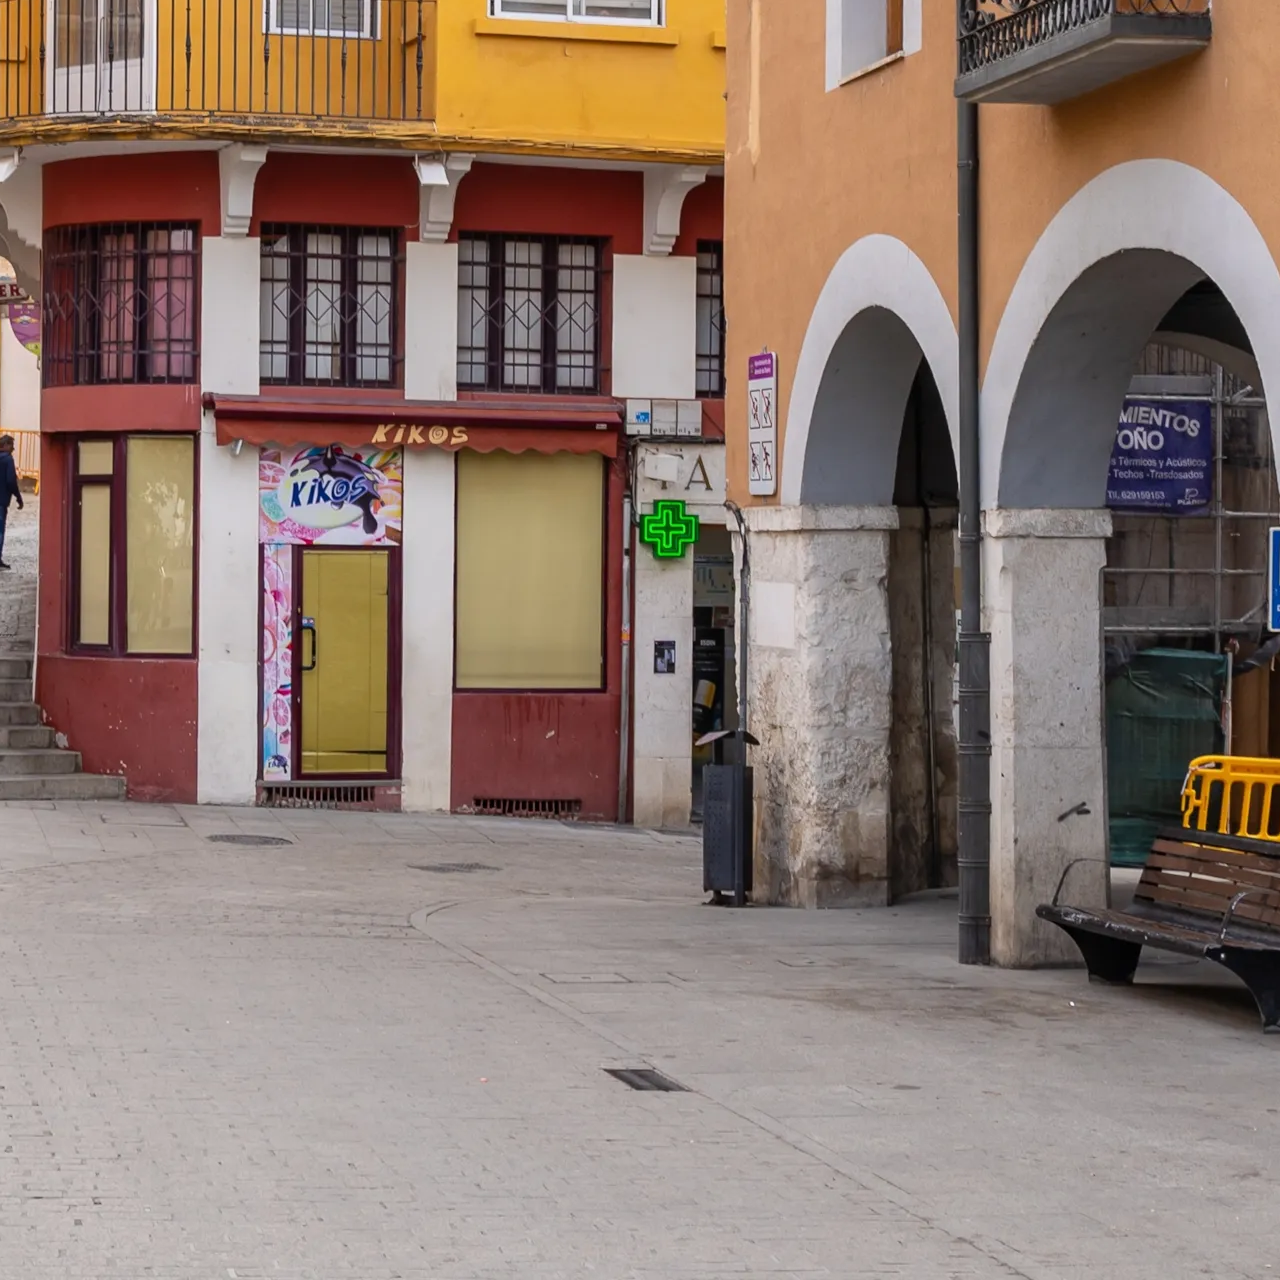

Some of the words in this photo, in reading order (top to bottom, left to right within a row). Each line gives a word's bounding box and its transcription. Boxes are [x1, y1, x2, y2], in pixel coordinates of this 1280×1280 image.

[1119, 406, 1201, 437] MIENTOS
[1116, 426, 1165, 451] OÑO
[1113, 469, 1144, 479] Techos
